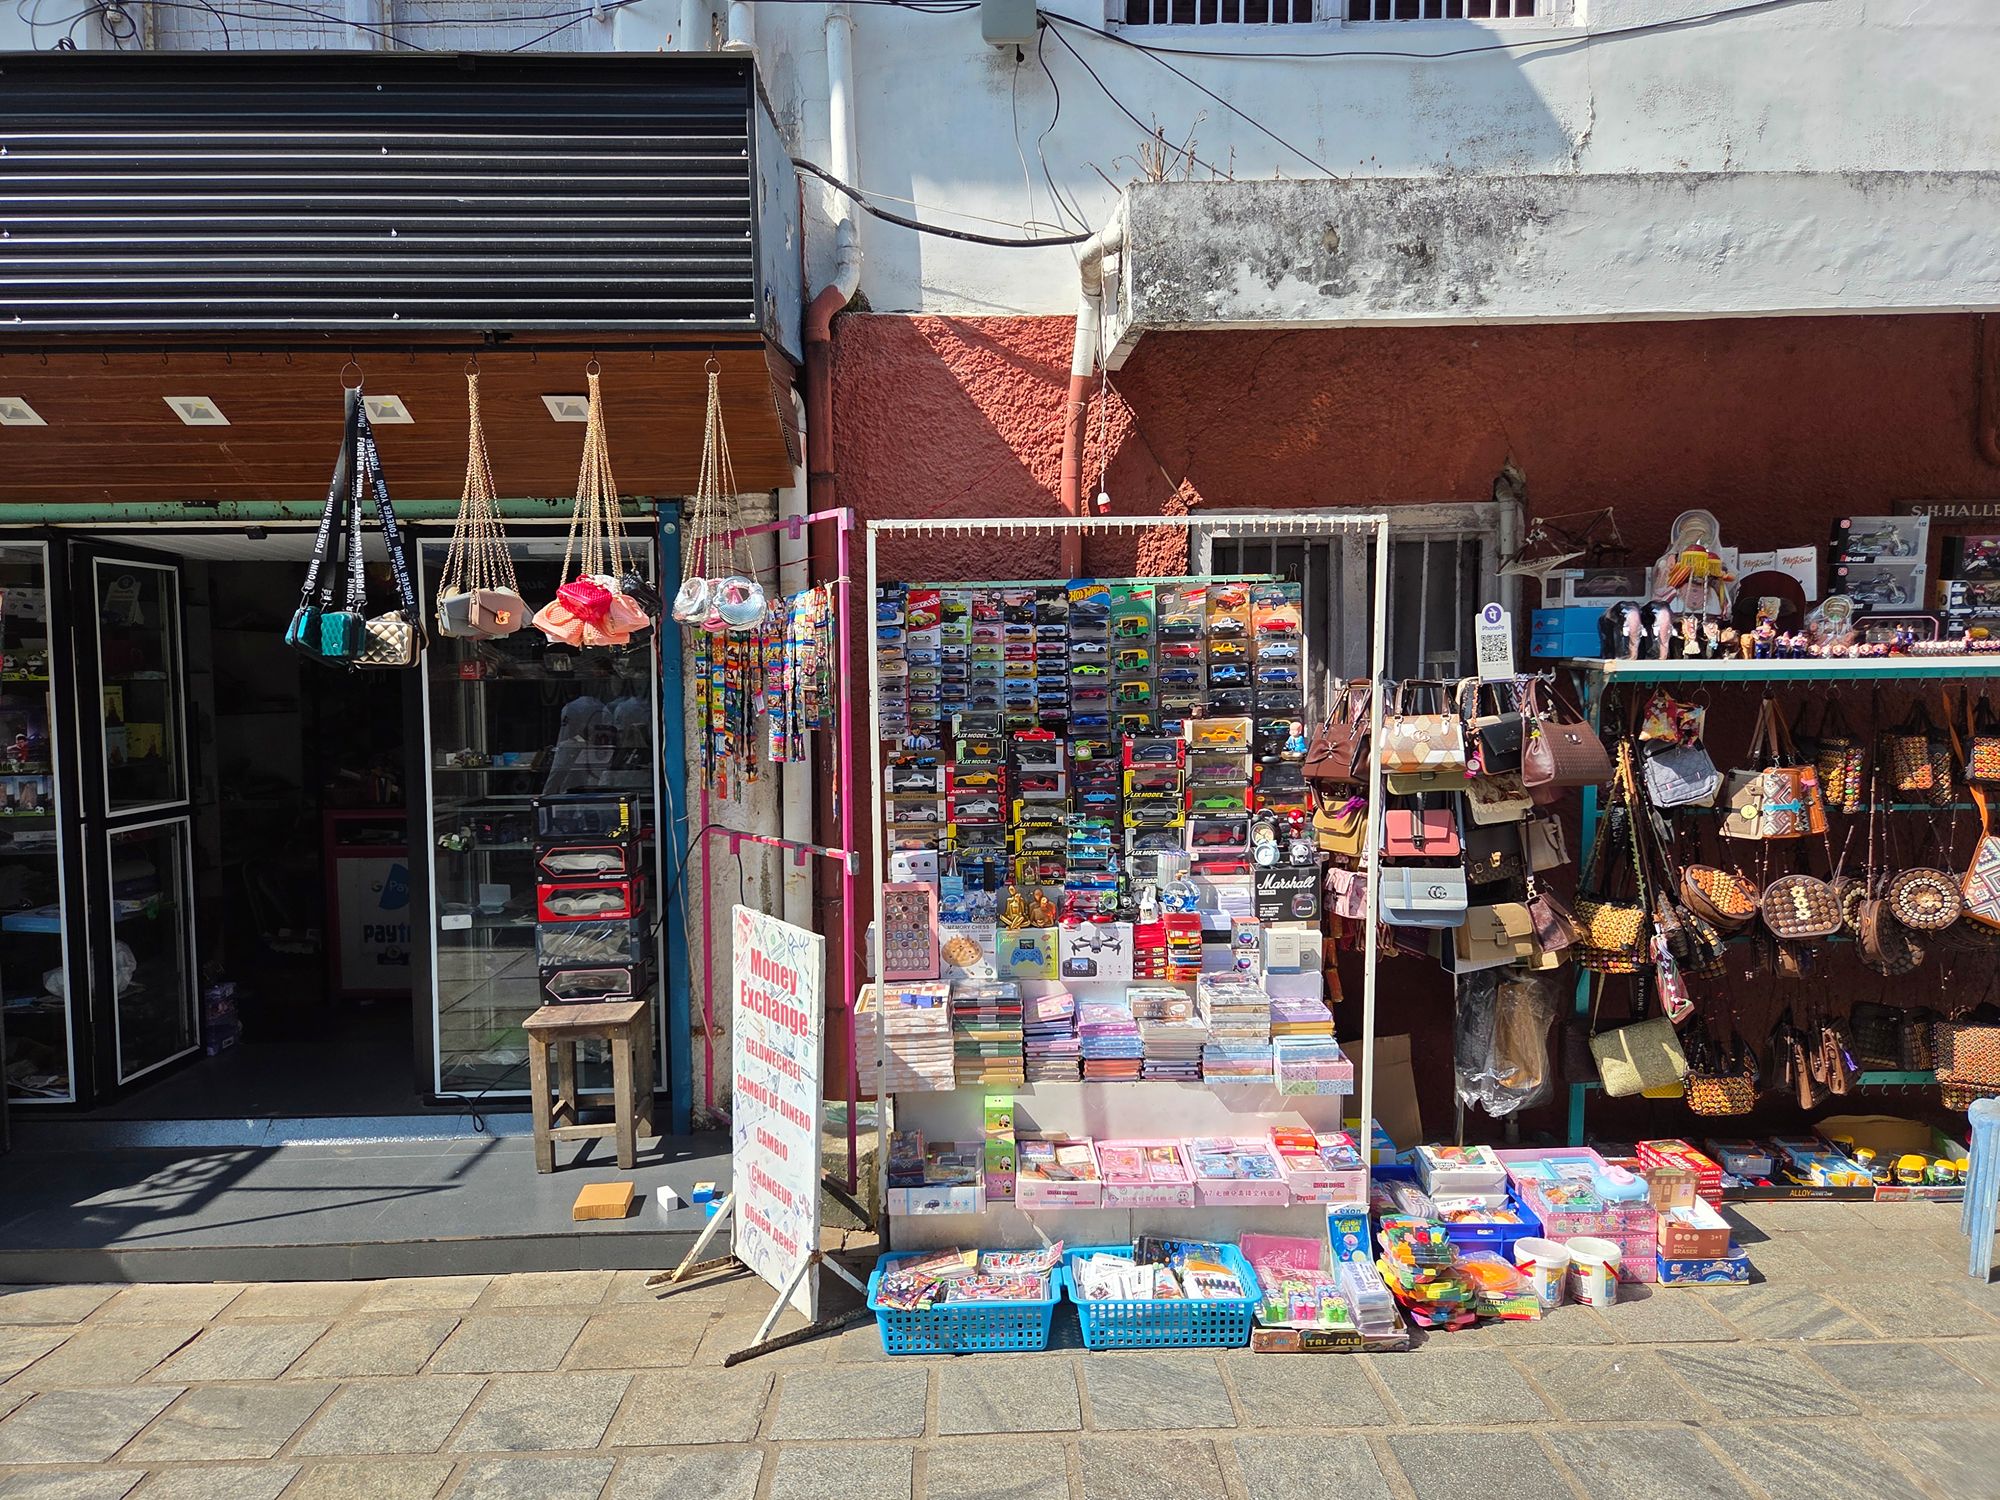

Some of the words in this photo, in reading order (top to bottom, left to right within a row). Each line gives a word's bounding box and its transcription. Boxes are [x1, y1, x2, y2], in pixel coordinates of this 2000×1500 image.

[356, 437, 366, 471] FOREVER
[366, 438, 381, 471] FOREVER
[356, 474, 365, 498] YOUNG
[376, 479, 389, 503] YOUNG
[315, 516, 331, 554] FOREVER
[382, 505, 398, 538] FOREVER
[355, 530, 363, 558] YOUNG
[394, 546, 409, 571] YOUNG
[346, 578, 356, 604] YOUNG
[356, 557, 365, 594] FOREVER
[400, 571, 416, 605] FOREVER
[998, 765, 1006, 793] CAR
[998, 794, 1007, 822] CAR
[1257, 873, 1316, 890] Marshall
[363, 923, 411, 943] payt
[750, 946, 797, 996] Money
[740, 979, 808, 1038] Exchange
[745, 1037, 802, 1082] GELDWECHSEL
[737, 1073, 768, 1106] CAMBIO
[769, 1094, 779, 1113] DE
[780, 1100, 812, 1133] DINERO
[756, 1126, 788, 1162] CAMBIO
[751, 1164, 793, 1209] CHANGEUR
[1789, 1189, 1811, 1197] ALLOY
[772, 1230, 799, 1259] денег
